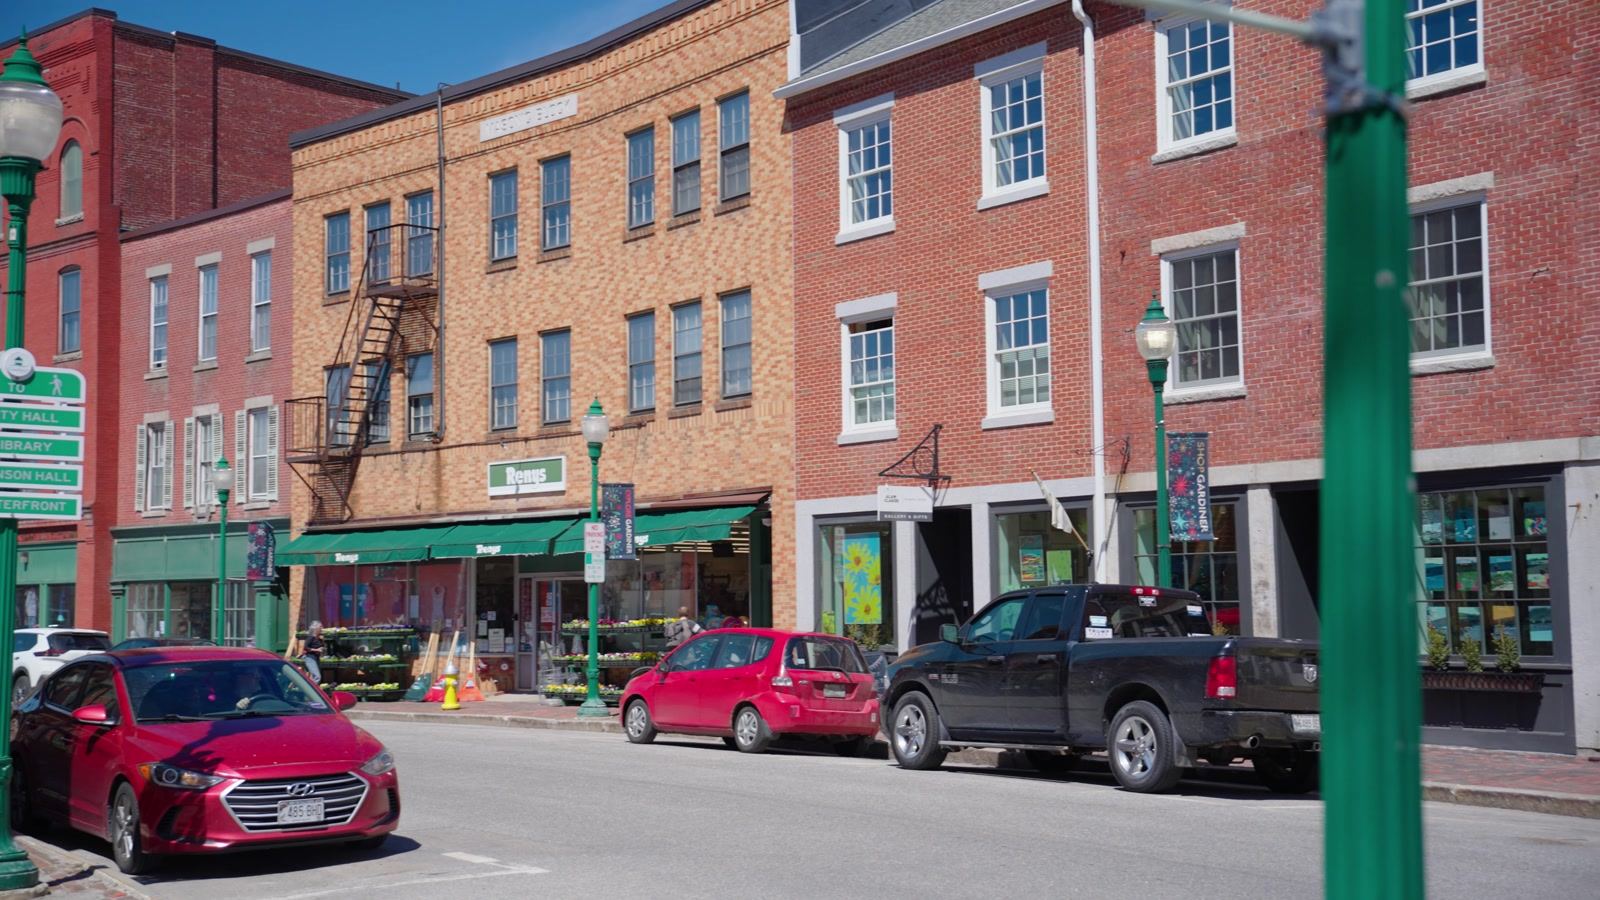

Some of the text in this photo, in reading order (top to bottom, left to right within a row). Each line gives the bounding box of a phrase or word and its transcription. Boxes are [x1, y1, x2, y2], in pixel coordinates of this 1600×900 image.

[8, 382, 25, 393] TO
[22, 411, 59, 423] HALL
[0, 440, 53, 452] IBRARY
[35, 472, 71, 482] HALL
[1197, 441, 1209, 533] SHOP GARDINER
[624, 519, 633, 554] GARDINER
